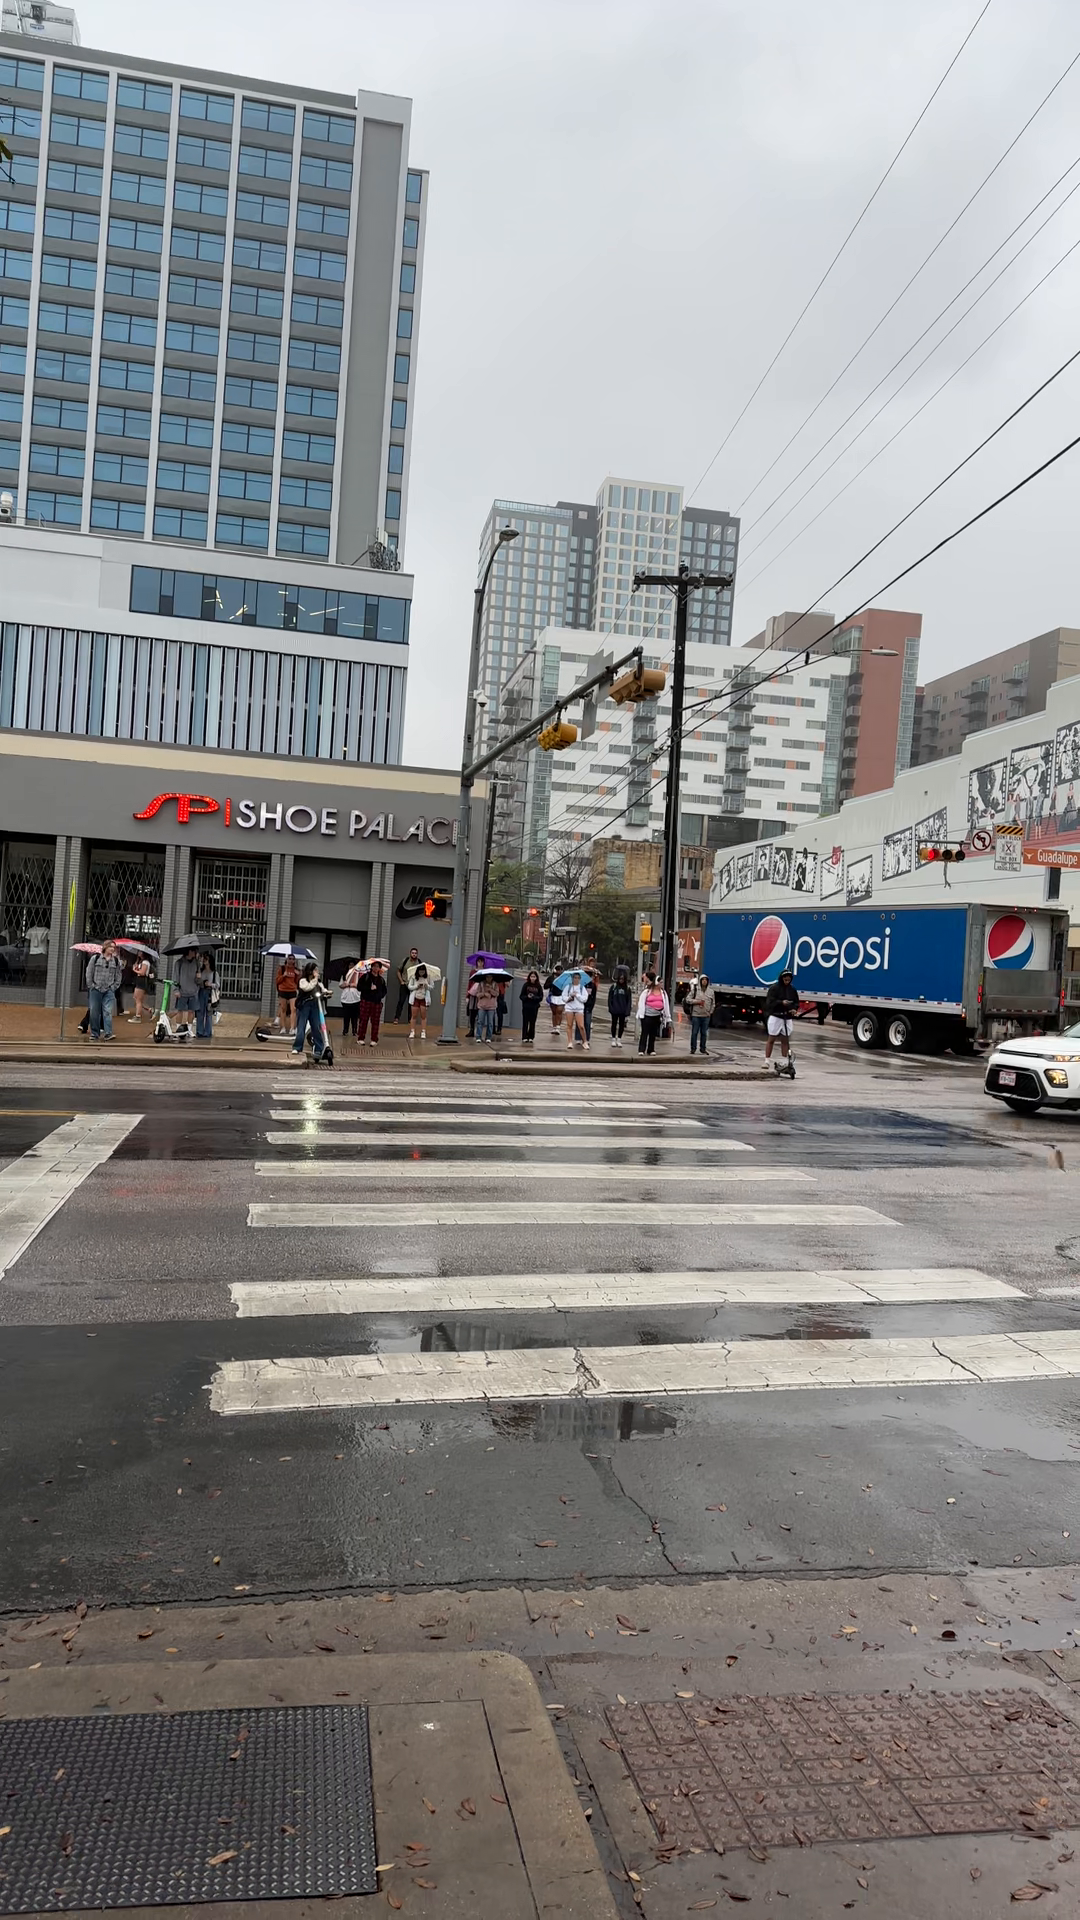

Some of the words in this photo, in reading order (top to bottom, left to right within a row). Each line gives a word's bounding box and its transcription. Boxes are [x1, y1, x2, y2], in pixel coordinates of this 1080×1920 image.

[236, 799, 338, 835] SHOE
[1037, 849, 1078, 867] Guadalupe
[793, 927, 891, 978] pepsi
